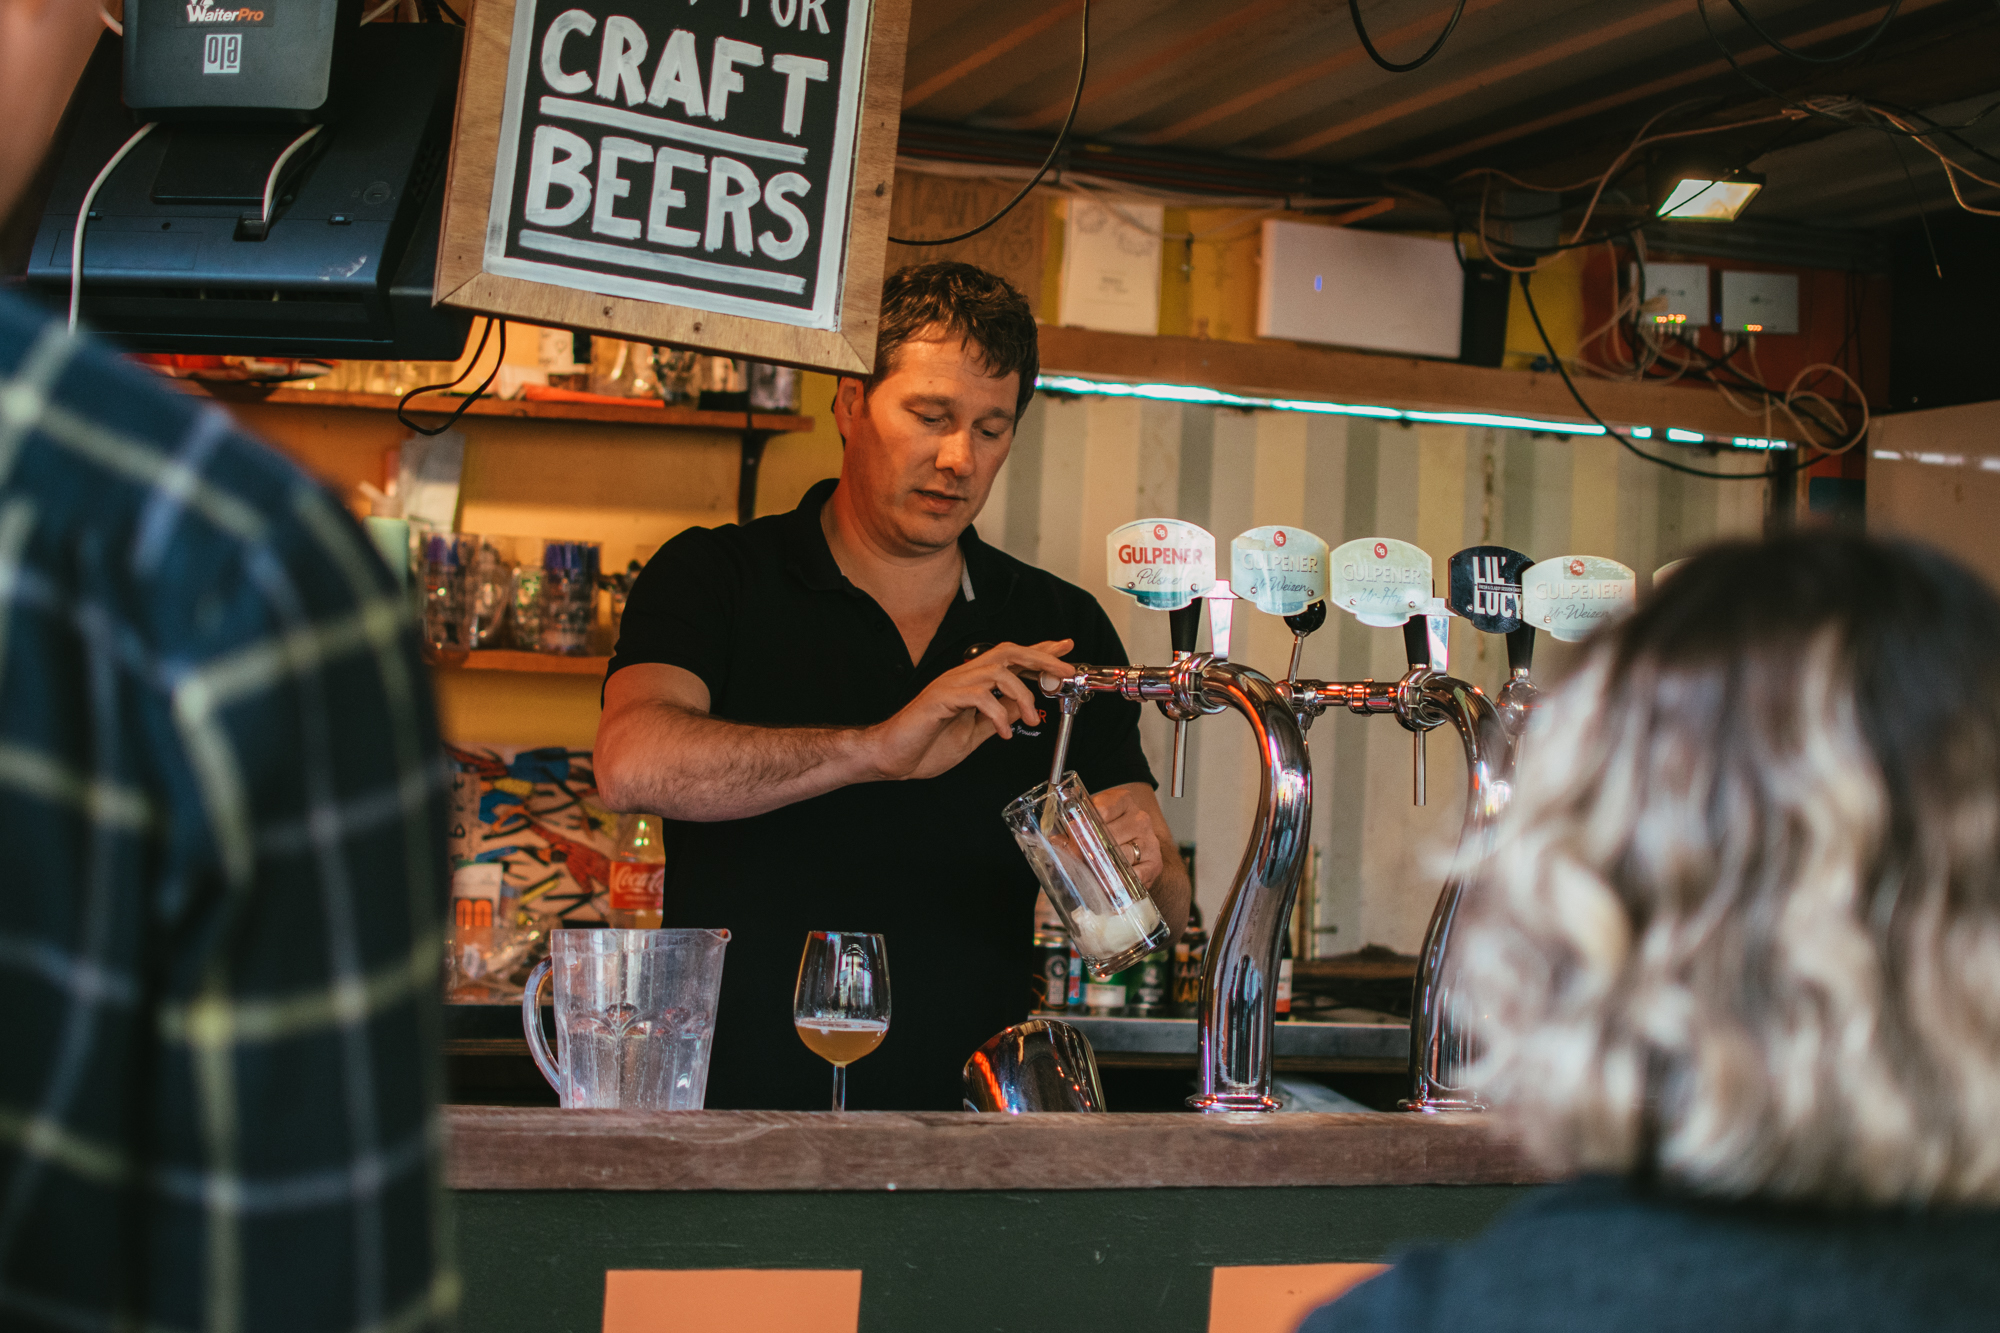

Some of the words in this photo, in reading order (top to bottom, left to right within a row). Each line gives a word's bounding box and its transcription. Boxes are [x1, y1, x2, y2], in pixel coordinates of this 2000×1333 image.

[186, 4, 265, 22] WaiterPro
[540, 9, 829, 138] CRAFT
[524, 125, 812, 261] BEERS
[1118, 544, 1203, 565] GULPENER
[1242, 553, 1319, 573] GULPENER
[1343, 562, 1422, 585] GULPENER
[1535, 581, 1623, 600] GULPENER
